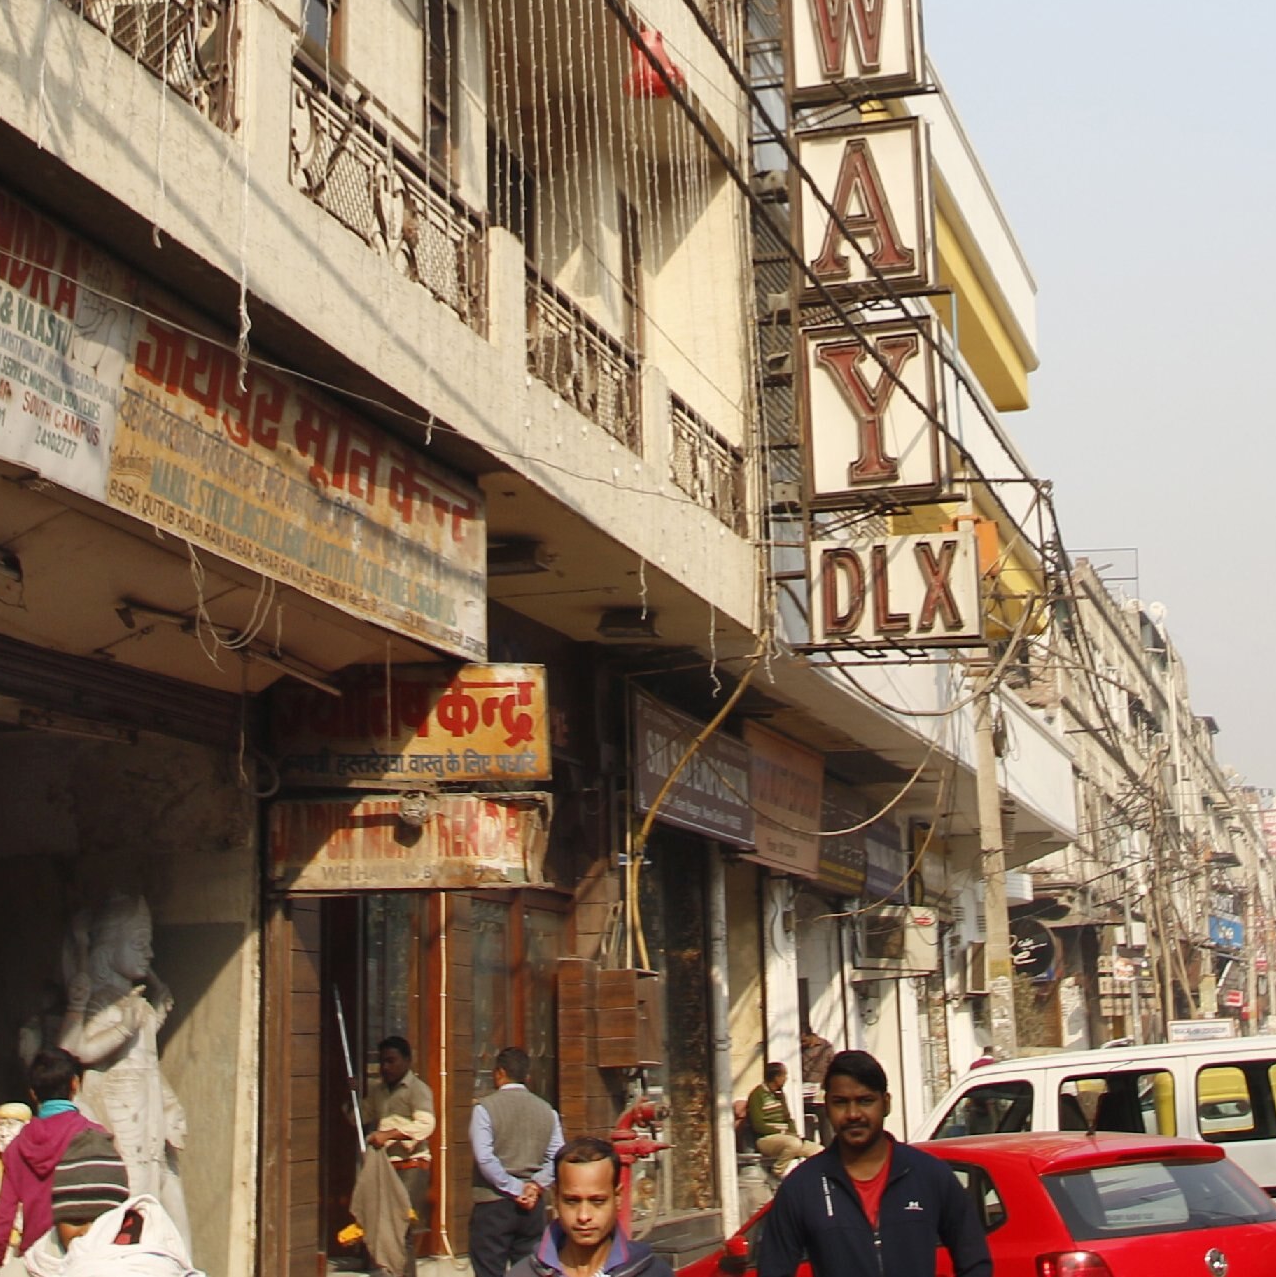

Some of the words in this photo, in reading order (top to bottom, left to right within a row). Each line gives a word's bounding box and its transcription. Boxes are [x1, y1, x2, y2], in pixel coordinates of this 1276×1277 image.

[21, 389, 53, 424] SOUTH
[53, 405, 101, 449] CAMPUS
[140, 491, 176, 526] QUTUB
[176, 508, 204, 537] ROAD
[823, 538, 965, 636] DLX
[464, 748, 492, 775] लिए
